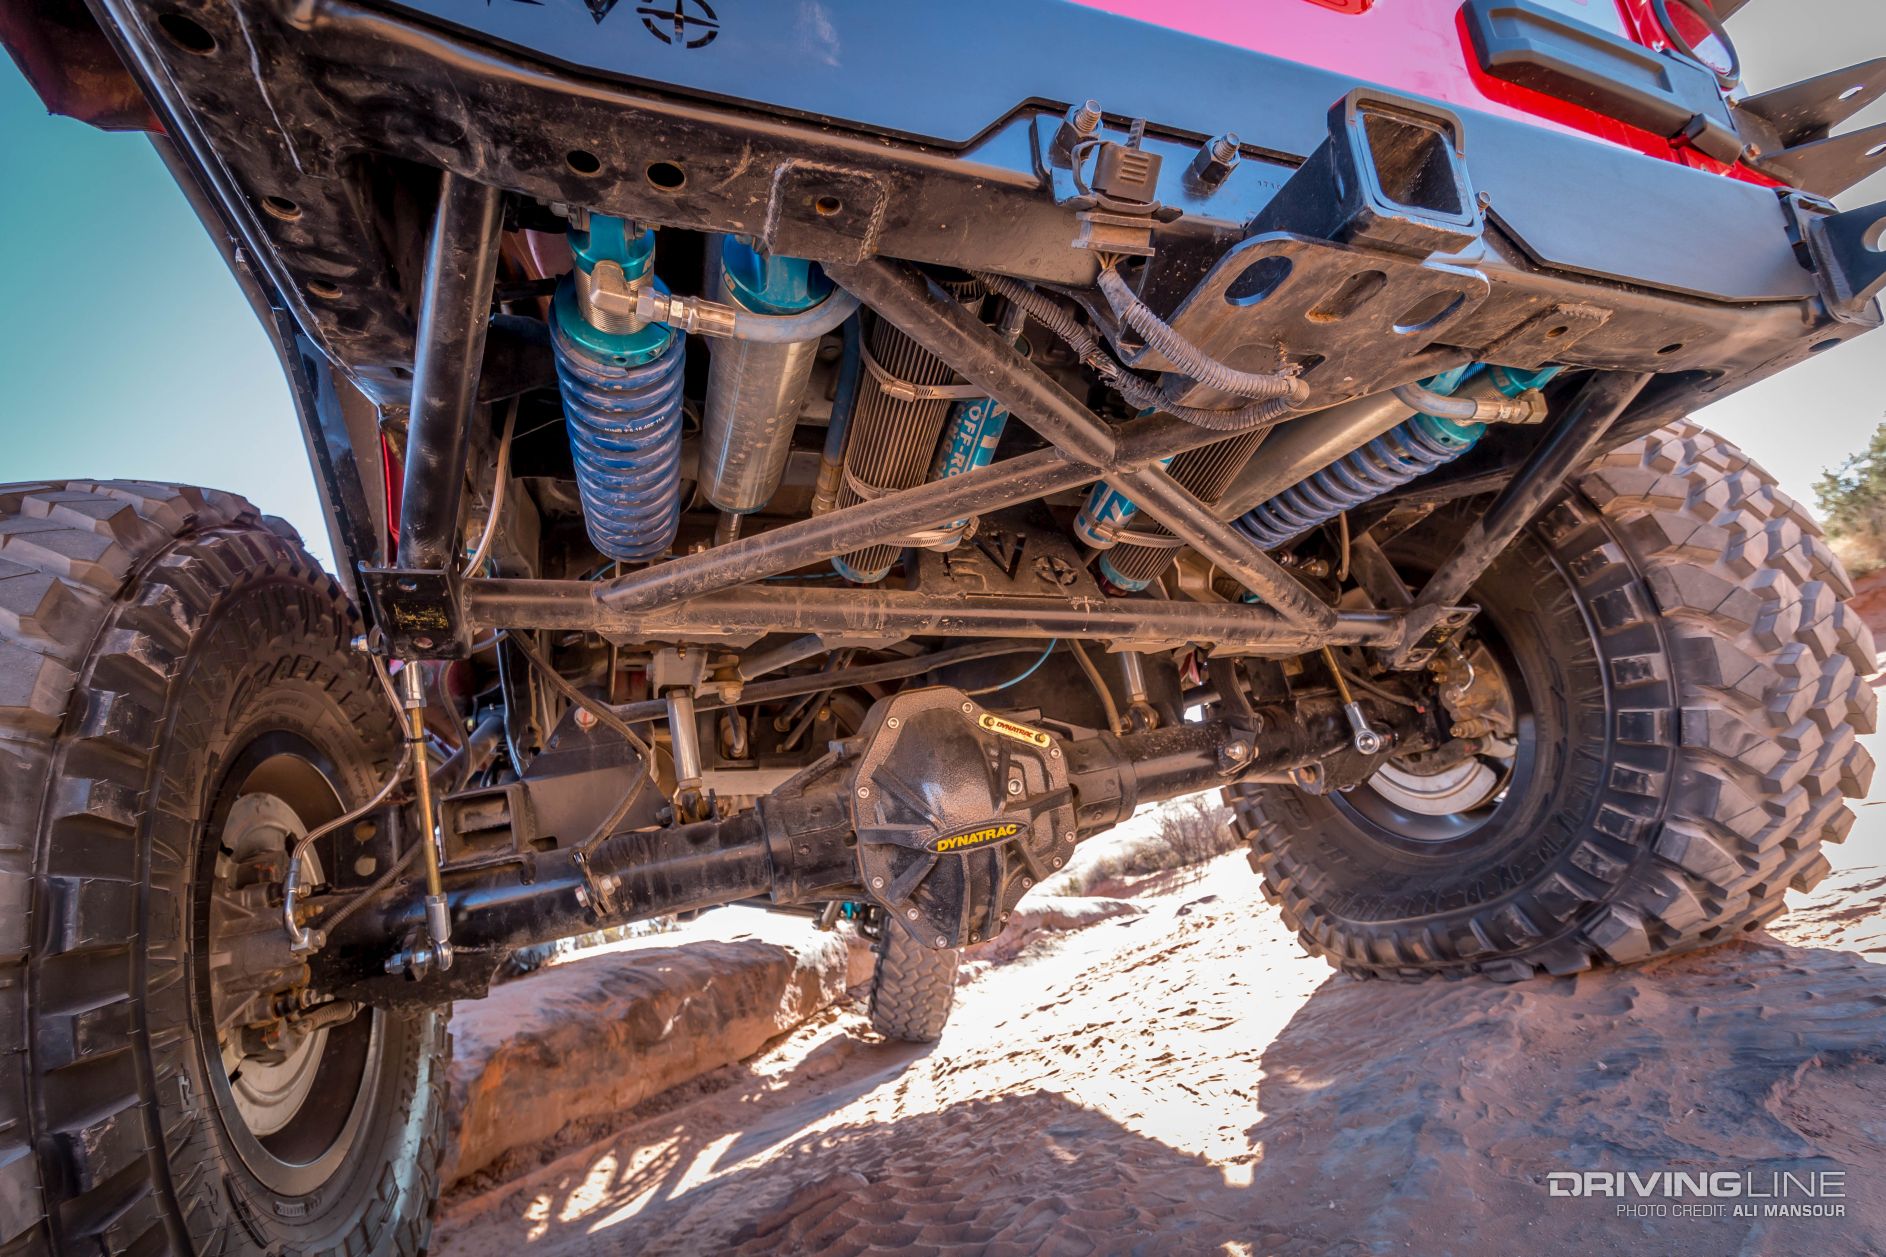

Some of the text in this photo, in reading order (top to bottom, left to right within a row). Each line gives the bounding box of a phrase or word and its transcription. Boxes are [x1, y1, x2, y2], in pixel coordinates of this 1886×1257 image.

[948, 405, 982, 477] OFF-RO
[996, 721, 1034, 738] DYNATRAC
[937, 824, 1017, 852] DYNATRAC
